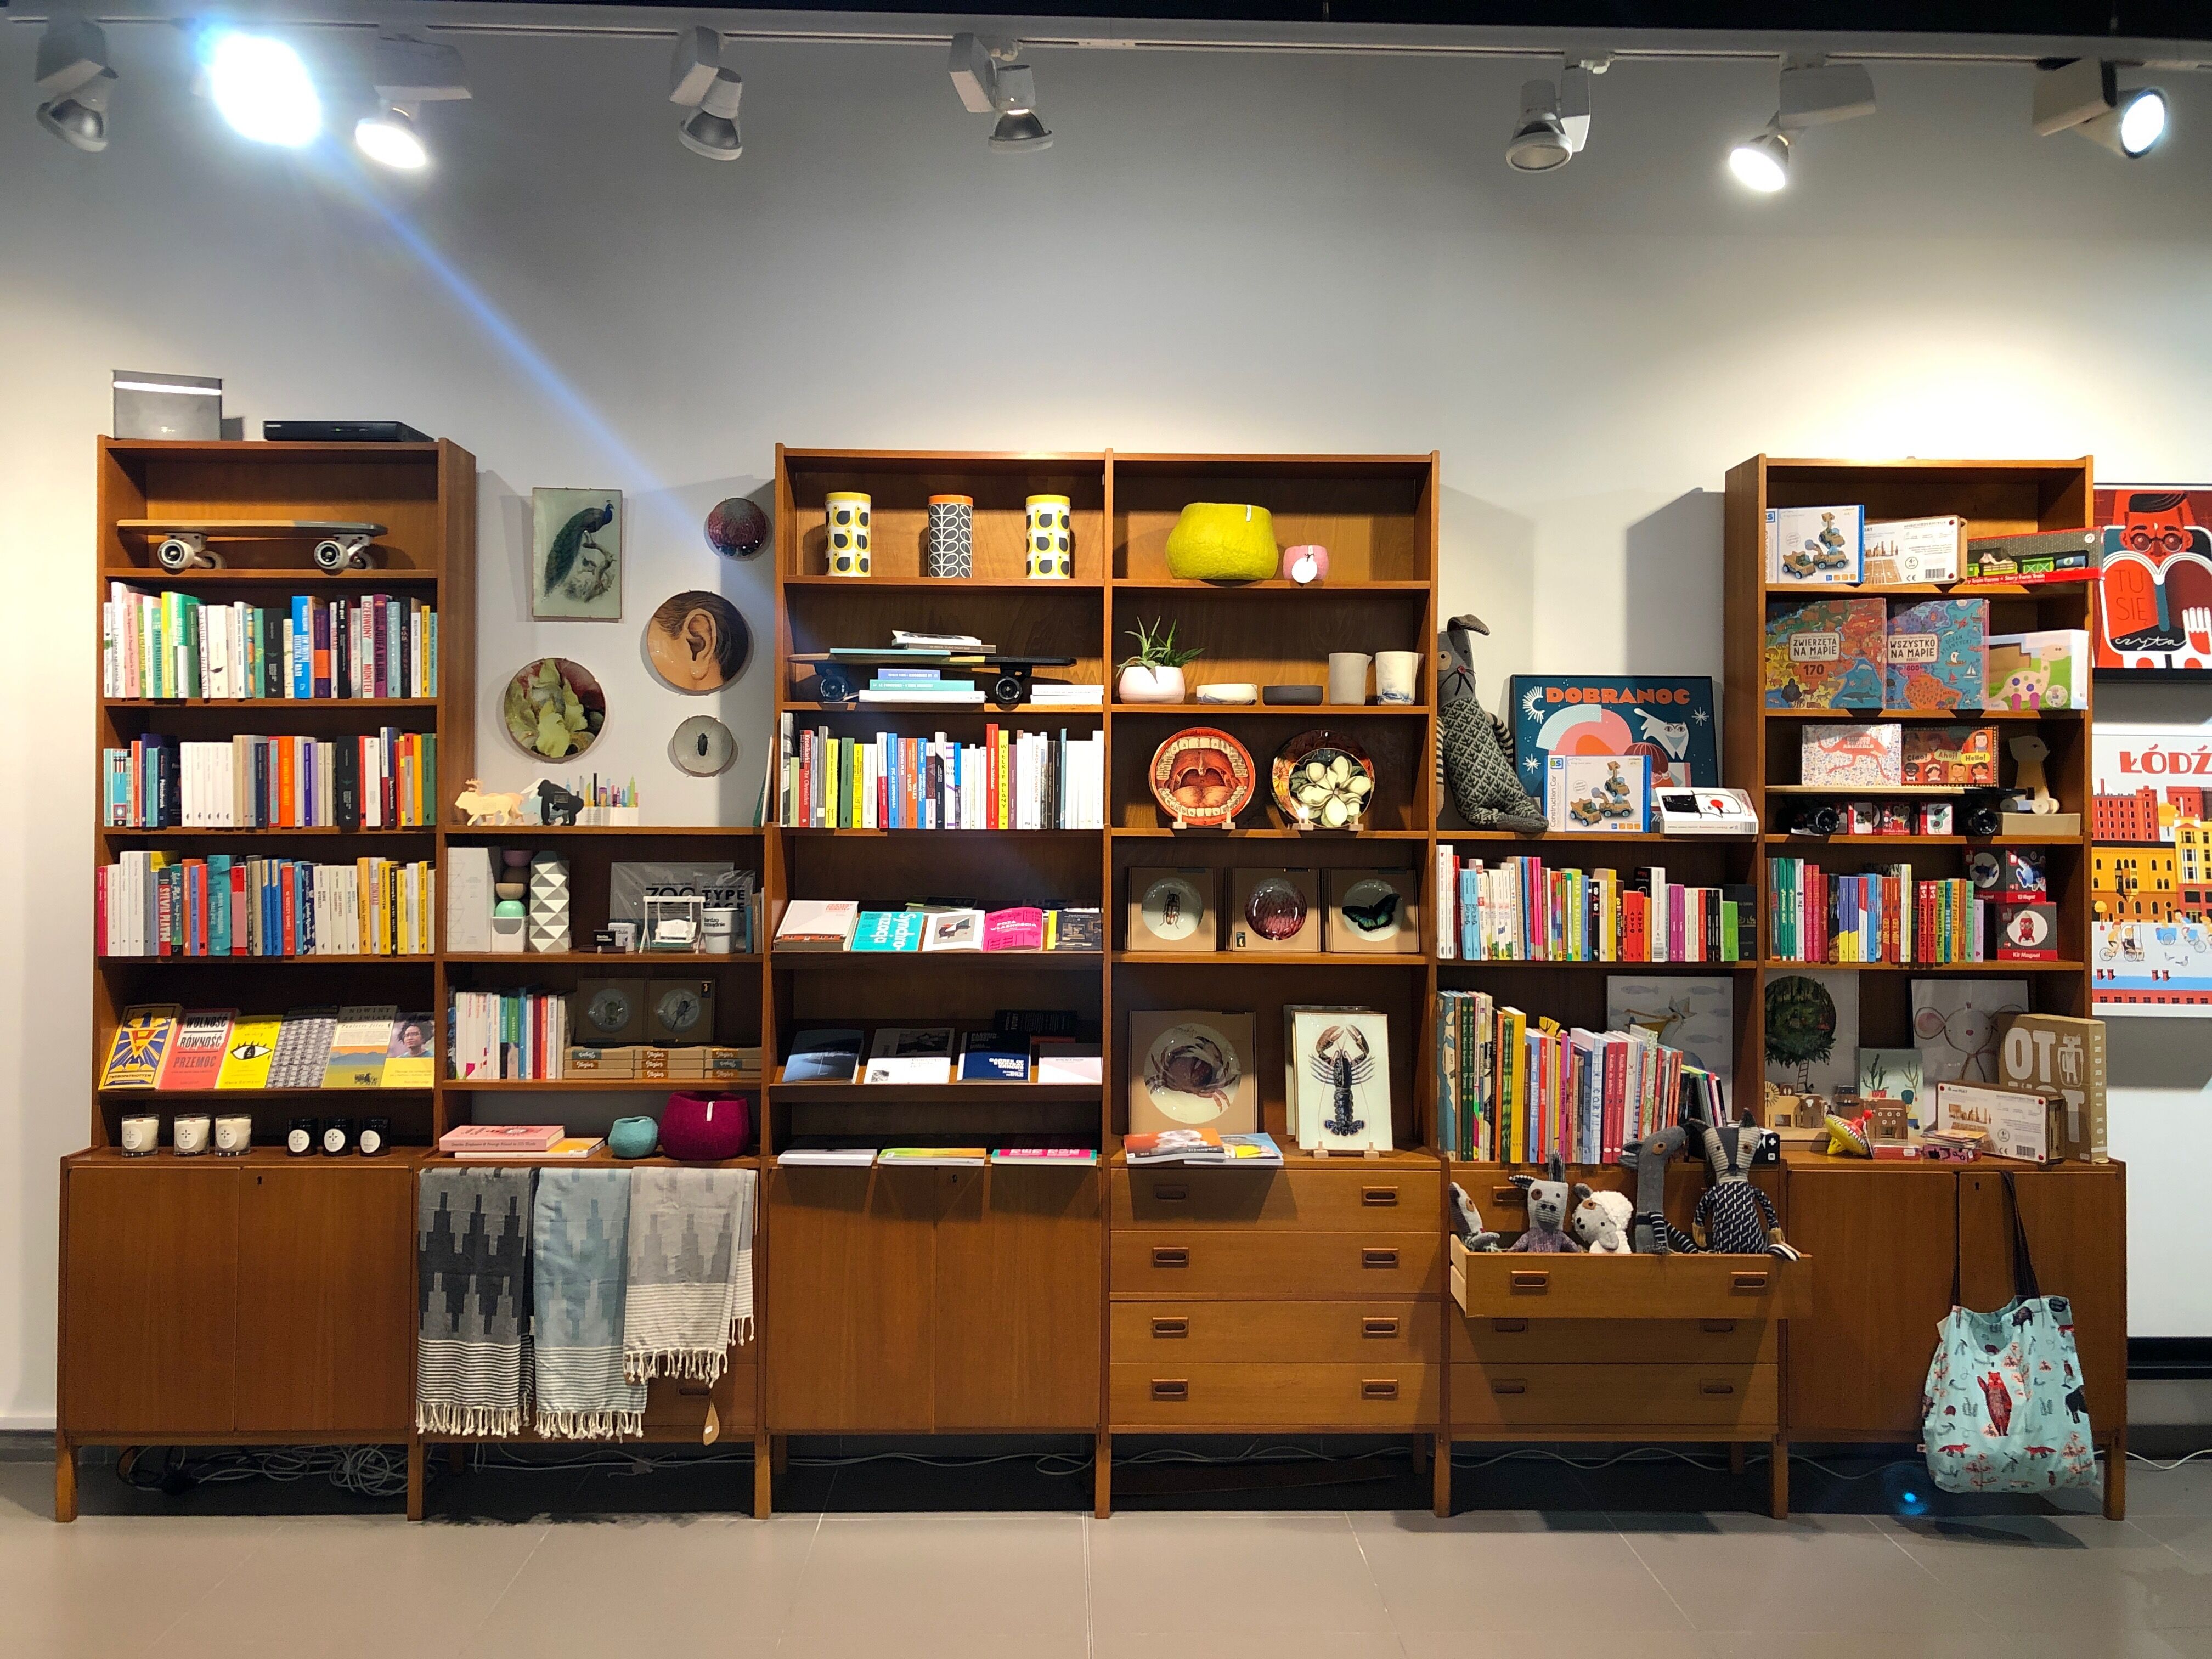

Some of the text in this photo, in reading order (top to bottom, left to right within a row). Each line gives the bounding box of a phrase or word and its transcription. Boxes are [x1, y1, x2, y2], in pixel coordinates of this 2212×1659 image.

[2114, 569, 2145, 593] TU
[2115, 596, 2148, 625] SIĘ
[363, 601, 373, 693] CZERWONY MONTER
[1792, 637, 1837, 647] ZWIERZĘTA
[1889, 639, 1936, 648] WSZYSTKO
[2115, 636, 2187, 651] czyta
[1793, 646, 1837, 656] NA MAPIE
[1891, 647, 1936, 658] NA MAPIE
[1803, 663, 1825, 675] 170
[1545, 686, 1691, 704] DOBRANOC
[1938, 752, 1957, 760] Ahoj!
[701, 889, 746, 900] TYPE
[1575, 897, 1580, 906] NA
[160, 888, 170, 943] SYLVIA PLATH
[186, 1013, 227, 1028] WOLNOŚĆ
[180, 1034, 223, 1048] RÓWNOŚĆ
[173, 1056, 217, 1068] PRZEMOC
[2094, 1035, 2104, 1146] ANDRZEJ KOT
